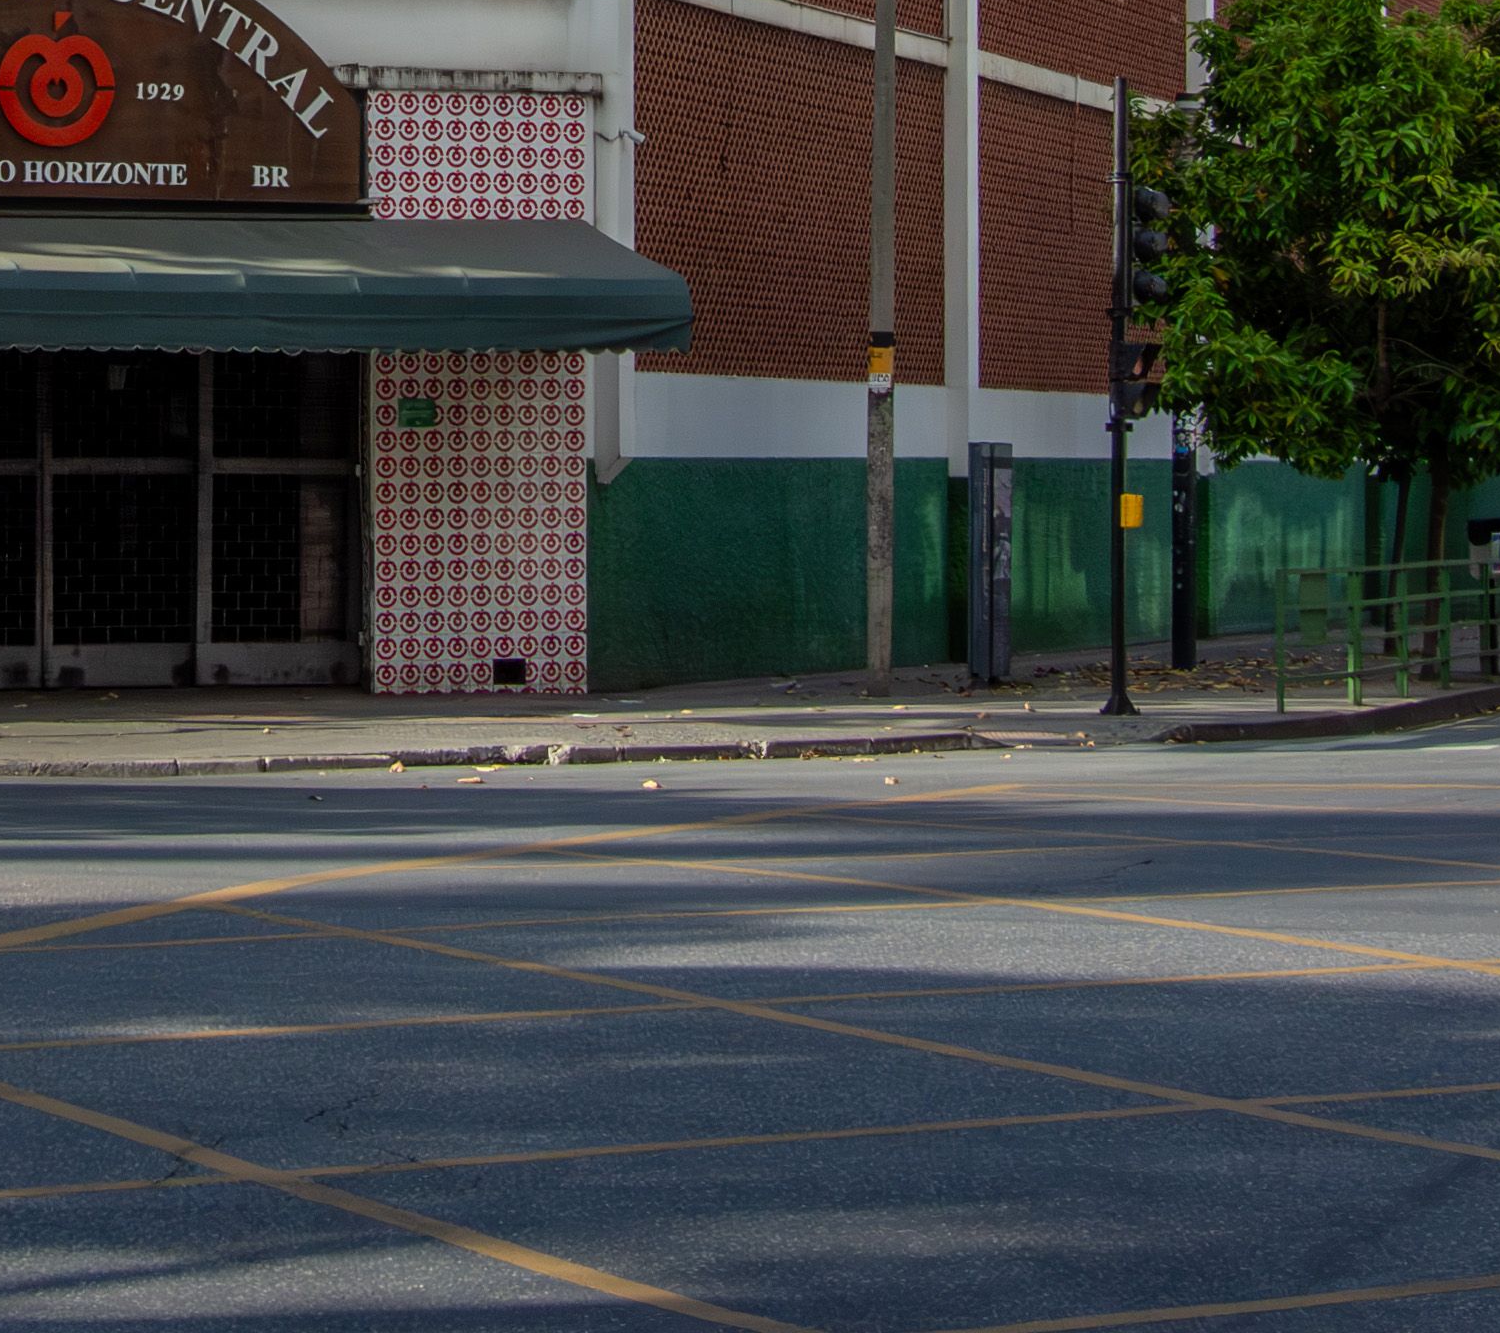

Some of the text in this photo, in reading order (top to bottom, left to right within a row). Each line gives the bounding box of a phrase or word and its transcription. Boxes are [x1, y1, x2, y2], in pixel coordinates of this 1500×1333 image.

[136, 82, 185, 102] 1929
[22, 160, 187, 187] HORIZONTE
[252, 165, 289, 188] BR
